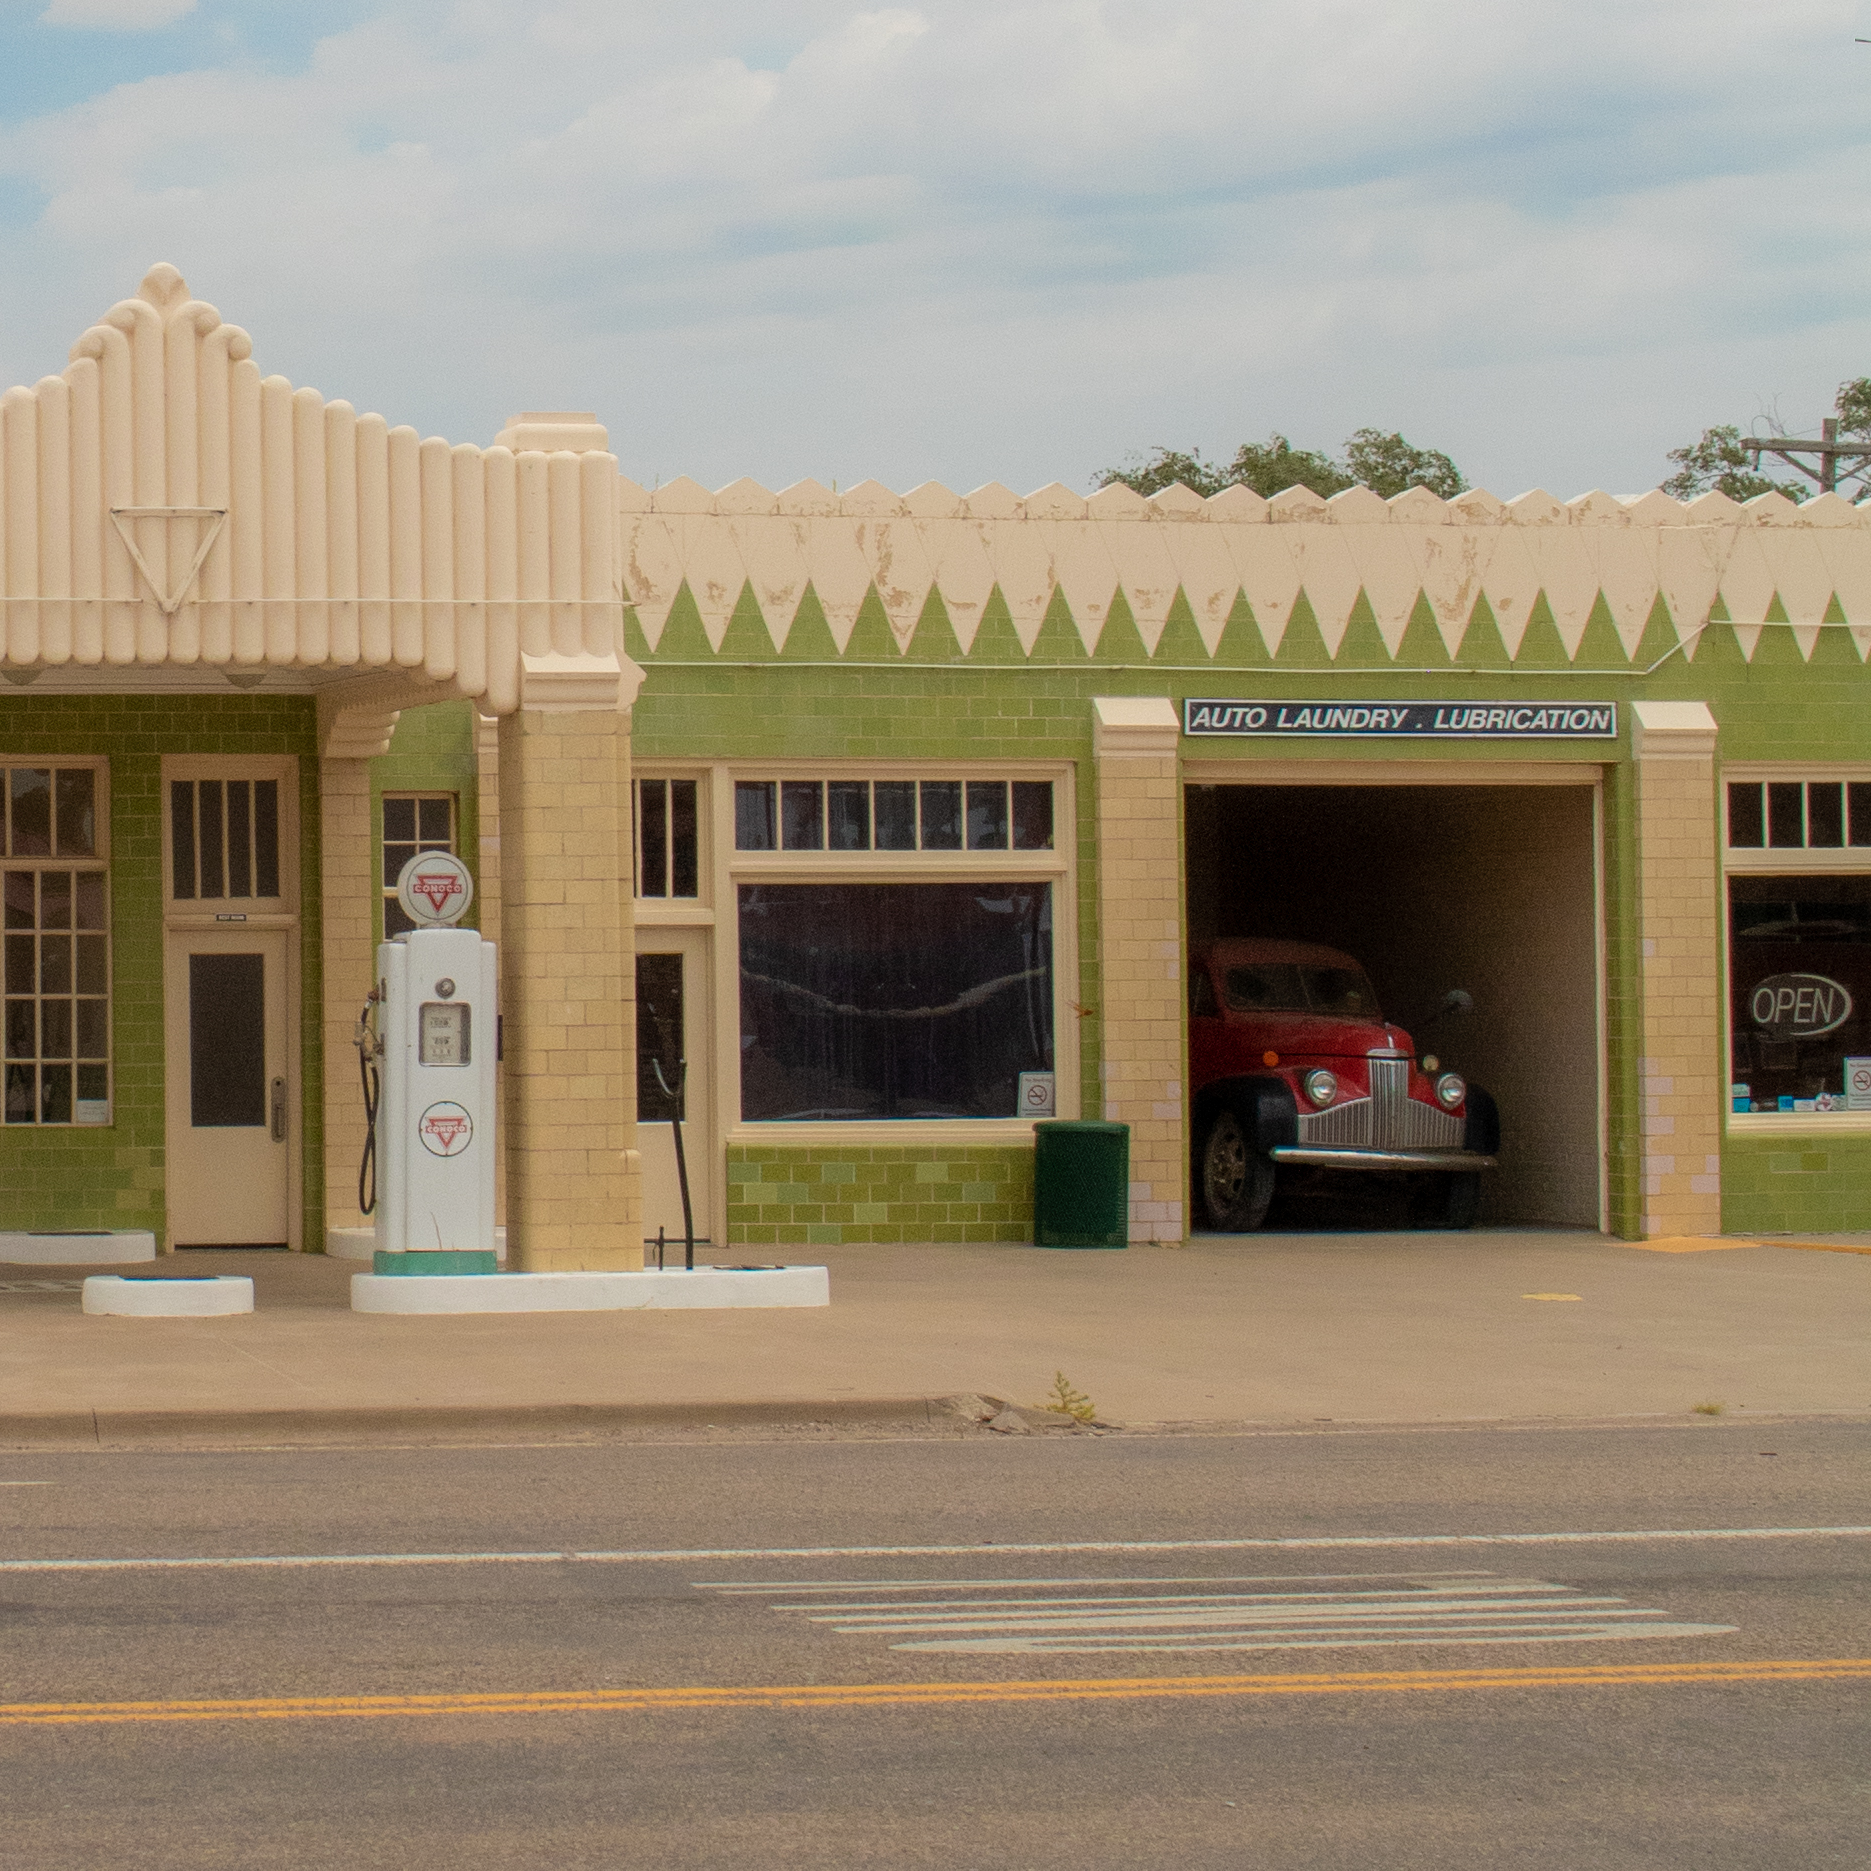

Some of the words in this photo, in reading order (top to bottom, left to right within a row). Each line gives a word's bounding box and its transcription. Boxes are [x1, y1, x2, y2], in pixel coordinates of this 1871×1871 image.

[1191, 707, 1268, 728] AUTO
[1277, 708, 1409, 729] LAUNDRY
[1434, 708, 1611, 729] LUBRICATION
[414, 884, 461, 893] CONOCO
[1753, 988, 1834, 1023] OPEN
